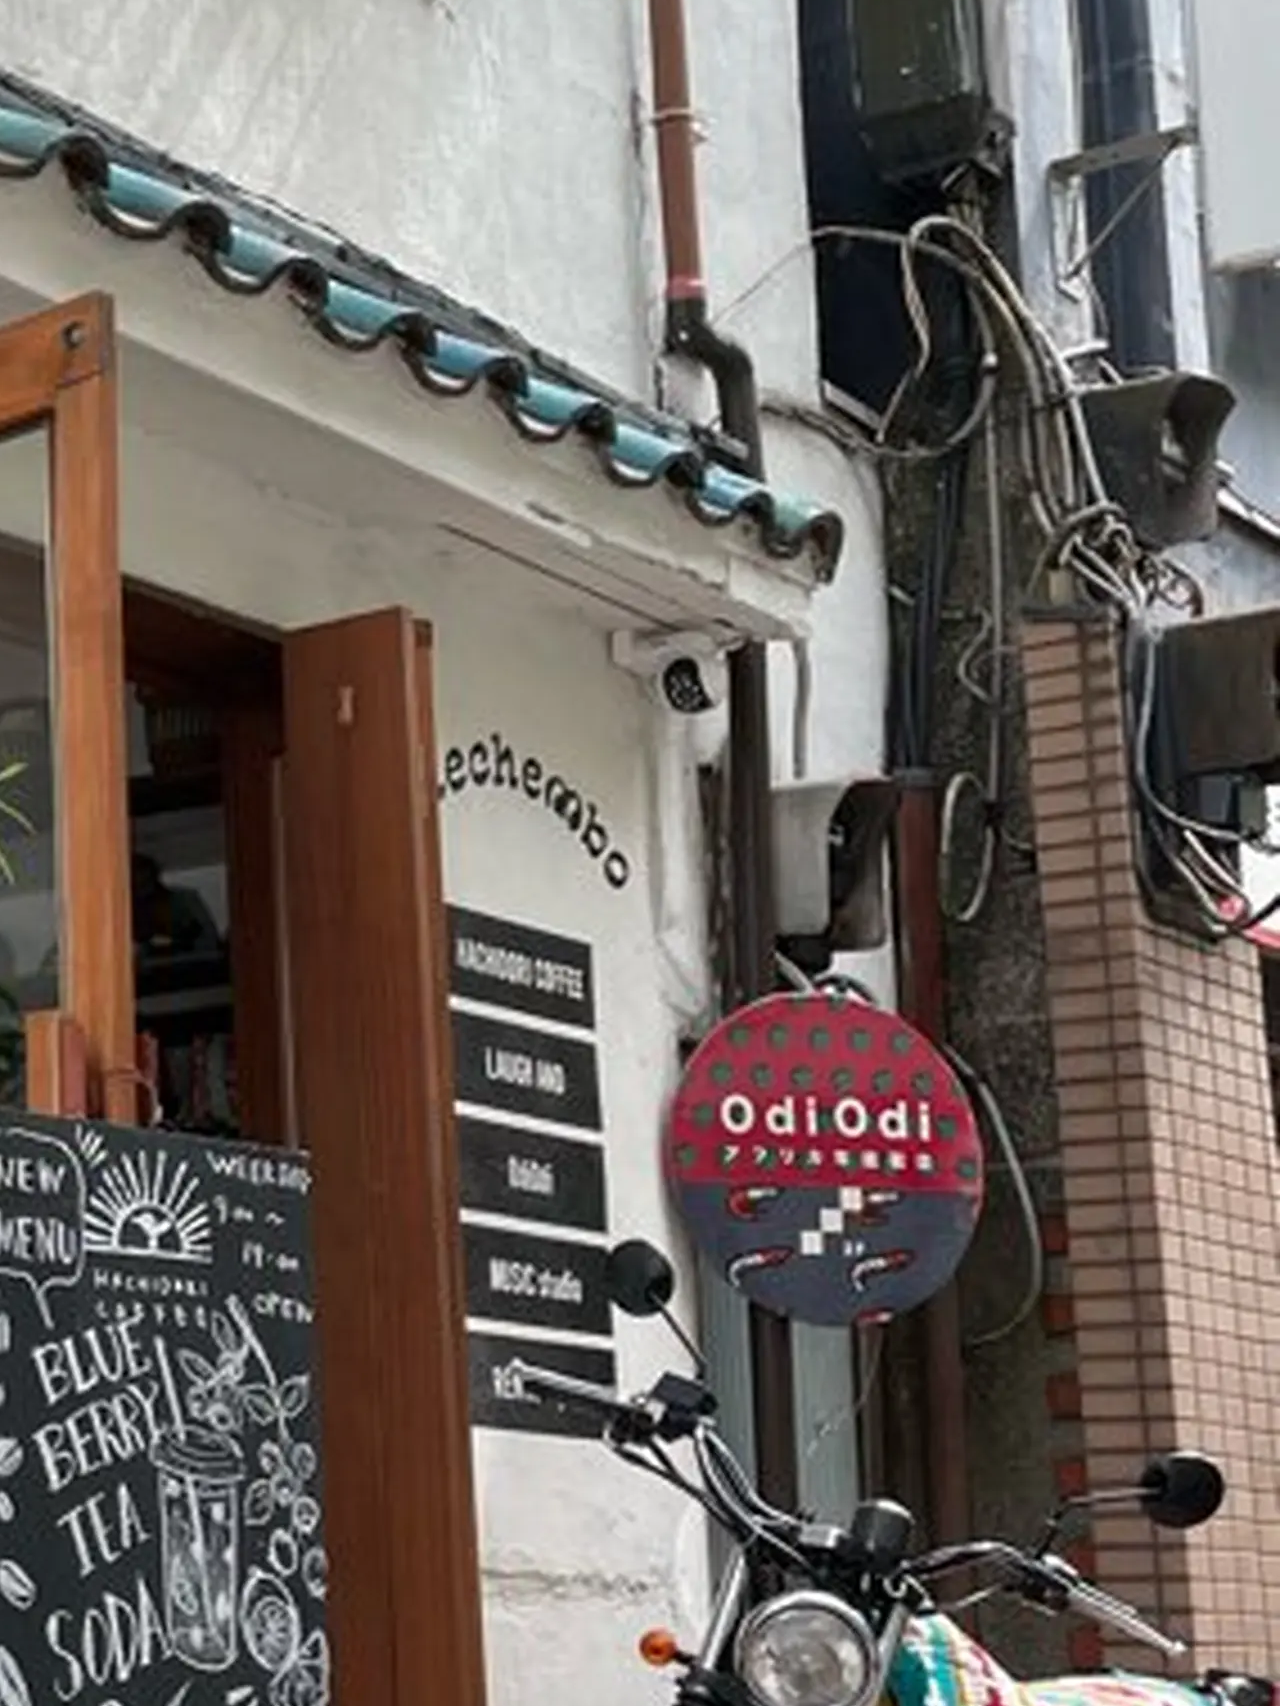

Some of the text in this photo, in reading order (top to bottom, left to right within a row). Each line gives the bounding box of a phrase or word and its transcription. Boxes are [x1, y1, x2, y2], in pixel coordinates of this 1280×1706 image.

[485, 1046, 533, 1087] LAUGH
[252, 1291, 316, 1324] OPEN
[489, 1258, 536, 1297] MUSIC
[31, 1316, 152, 1405] BLUE
[32, 1379, 164, 1492] BERRY
[56, 1482, 151, 1578] TEA
[46, 1567, 175, 1702] SODA
